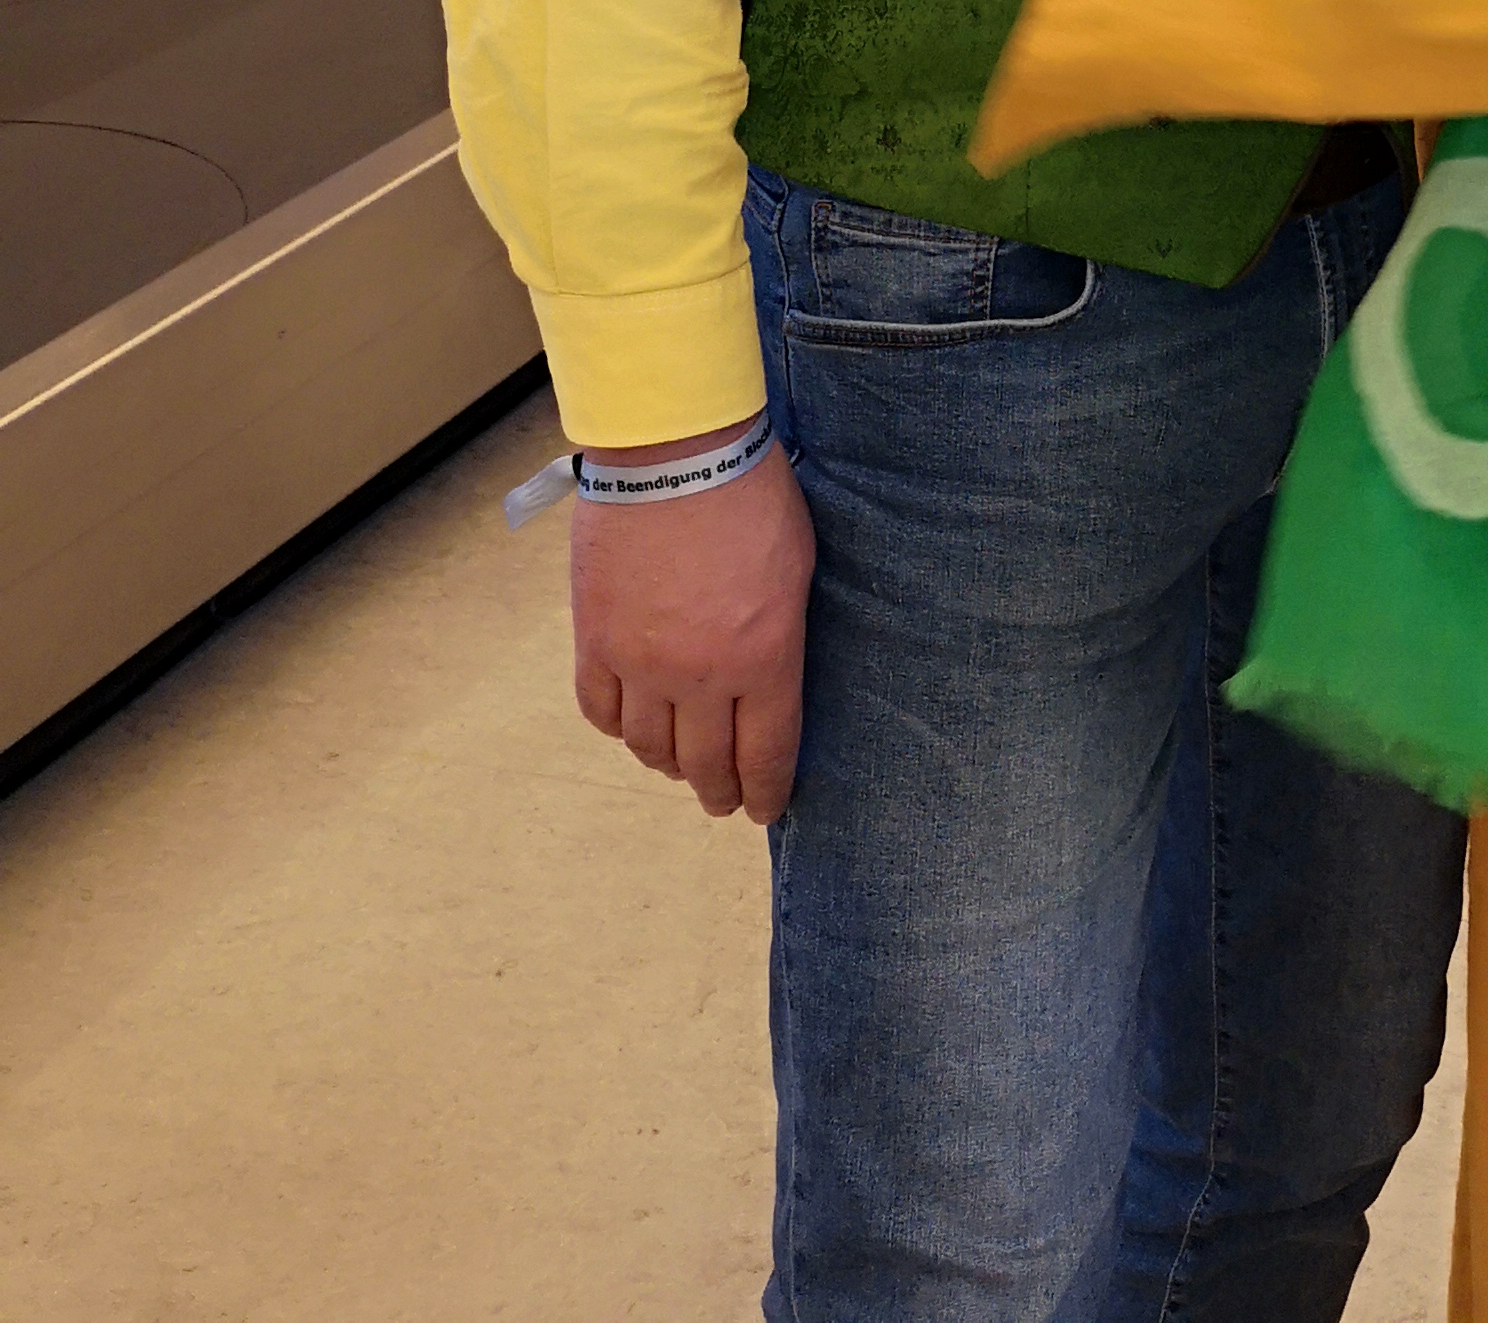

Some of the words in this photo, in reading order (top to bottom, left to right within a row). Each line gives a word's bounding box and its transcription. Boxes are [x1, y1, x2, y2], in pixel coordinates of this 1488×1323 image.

[592, 477, 614, 492] der
[617, 467, 712, 493] Beendigung
[716, 454, 742, 473] der
